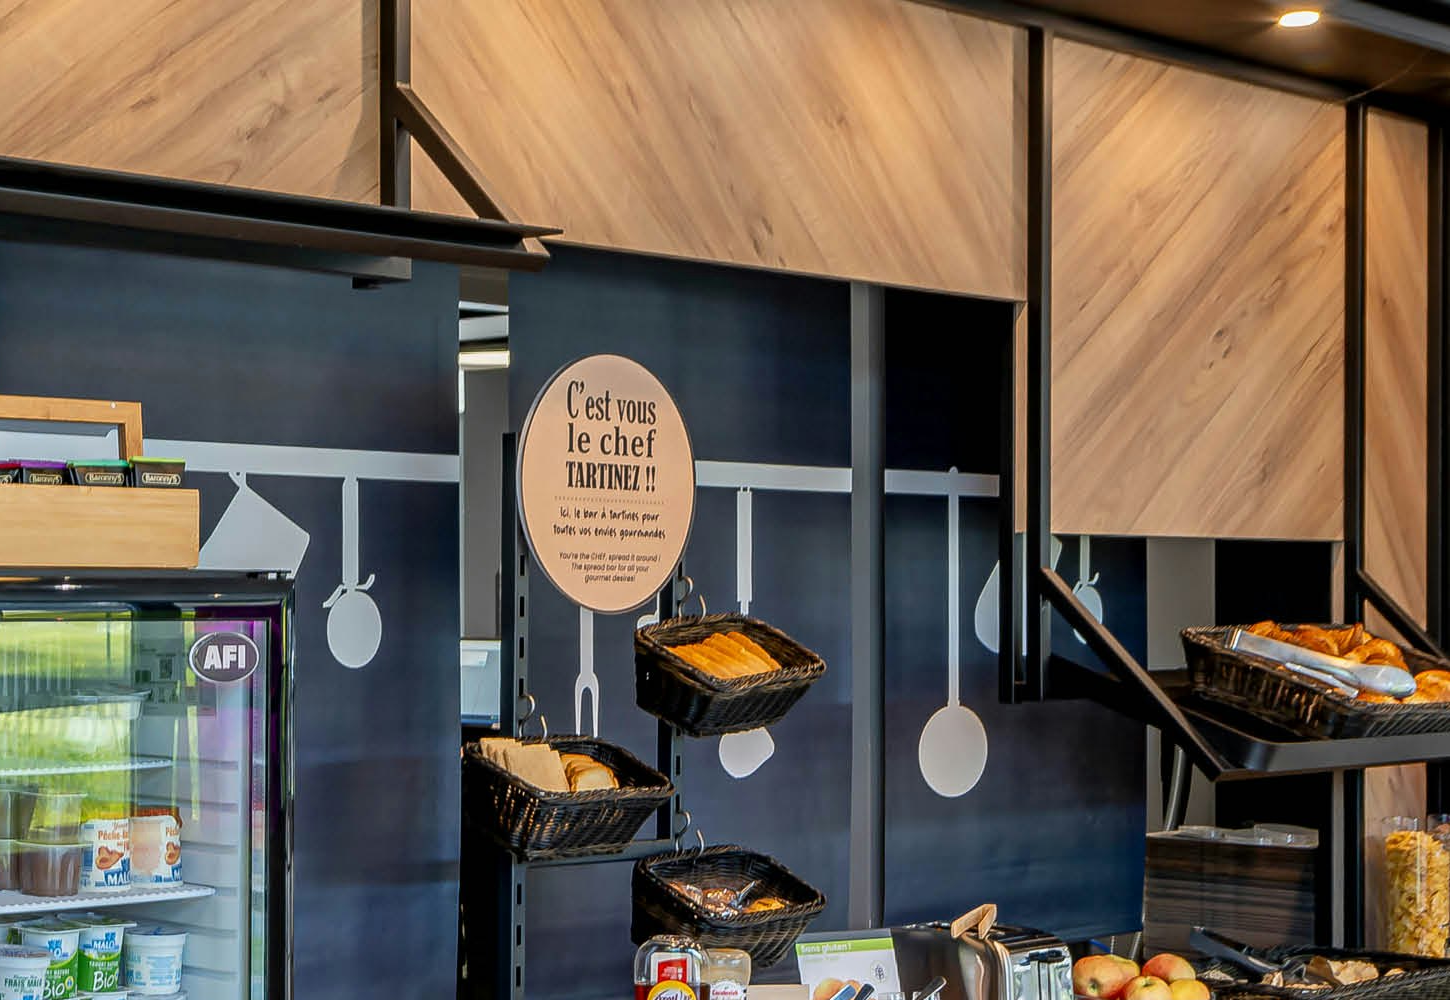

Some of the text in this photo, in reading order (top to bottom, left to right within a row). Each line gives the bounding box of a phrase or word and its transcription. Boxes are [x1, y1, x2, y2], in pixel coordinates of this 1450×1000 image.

[566, 380, 656, 425] C'est vous
[567, 422, 656, 458] le chef
[565, 461, 656, 493] TARTINEZ !!
[574, 508, 581, 519] le
[584, 508, 598, 519] bar
[610, 510, 639, 521] tartines
[642, 513, 660, 525] pour
[553, 524, 666, 541] toutes vos envies gourmandes
[203, 644, 246, 670] AFI
[93, 971, 114, 992] Bio
